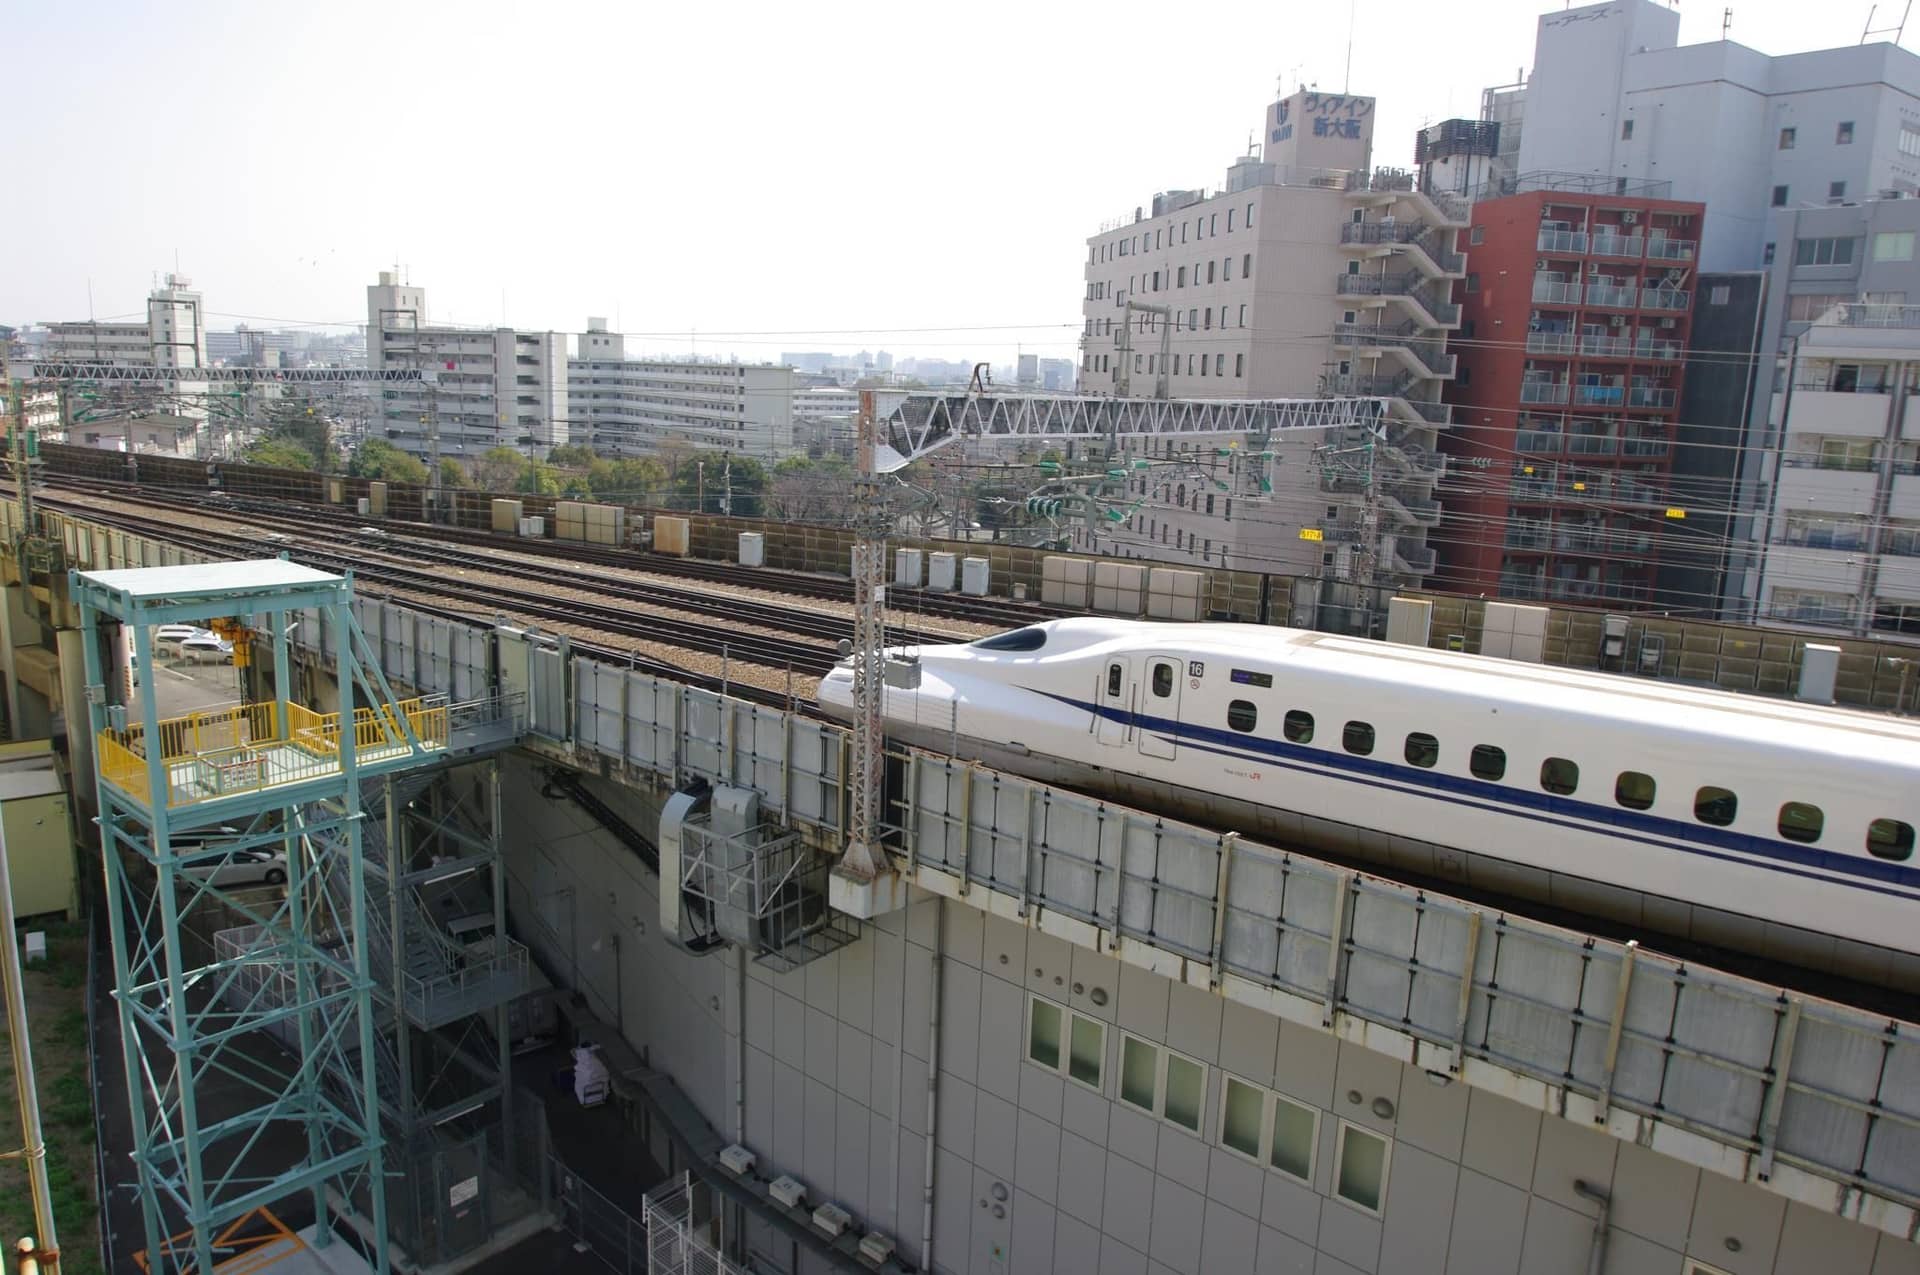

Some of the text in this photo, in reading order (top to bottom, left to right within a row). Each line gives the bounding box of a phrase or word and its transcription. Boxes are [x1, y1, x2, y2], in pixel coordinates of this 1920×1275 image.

[1312, 116, 1361, 139] 新大阪
[1191, 663, 1202, 676] 16
